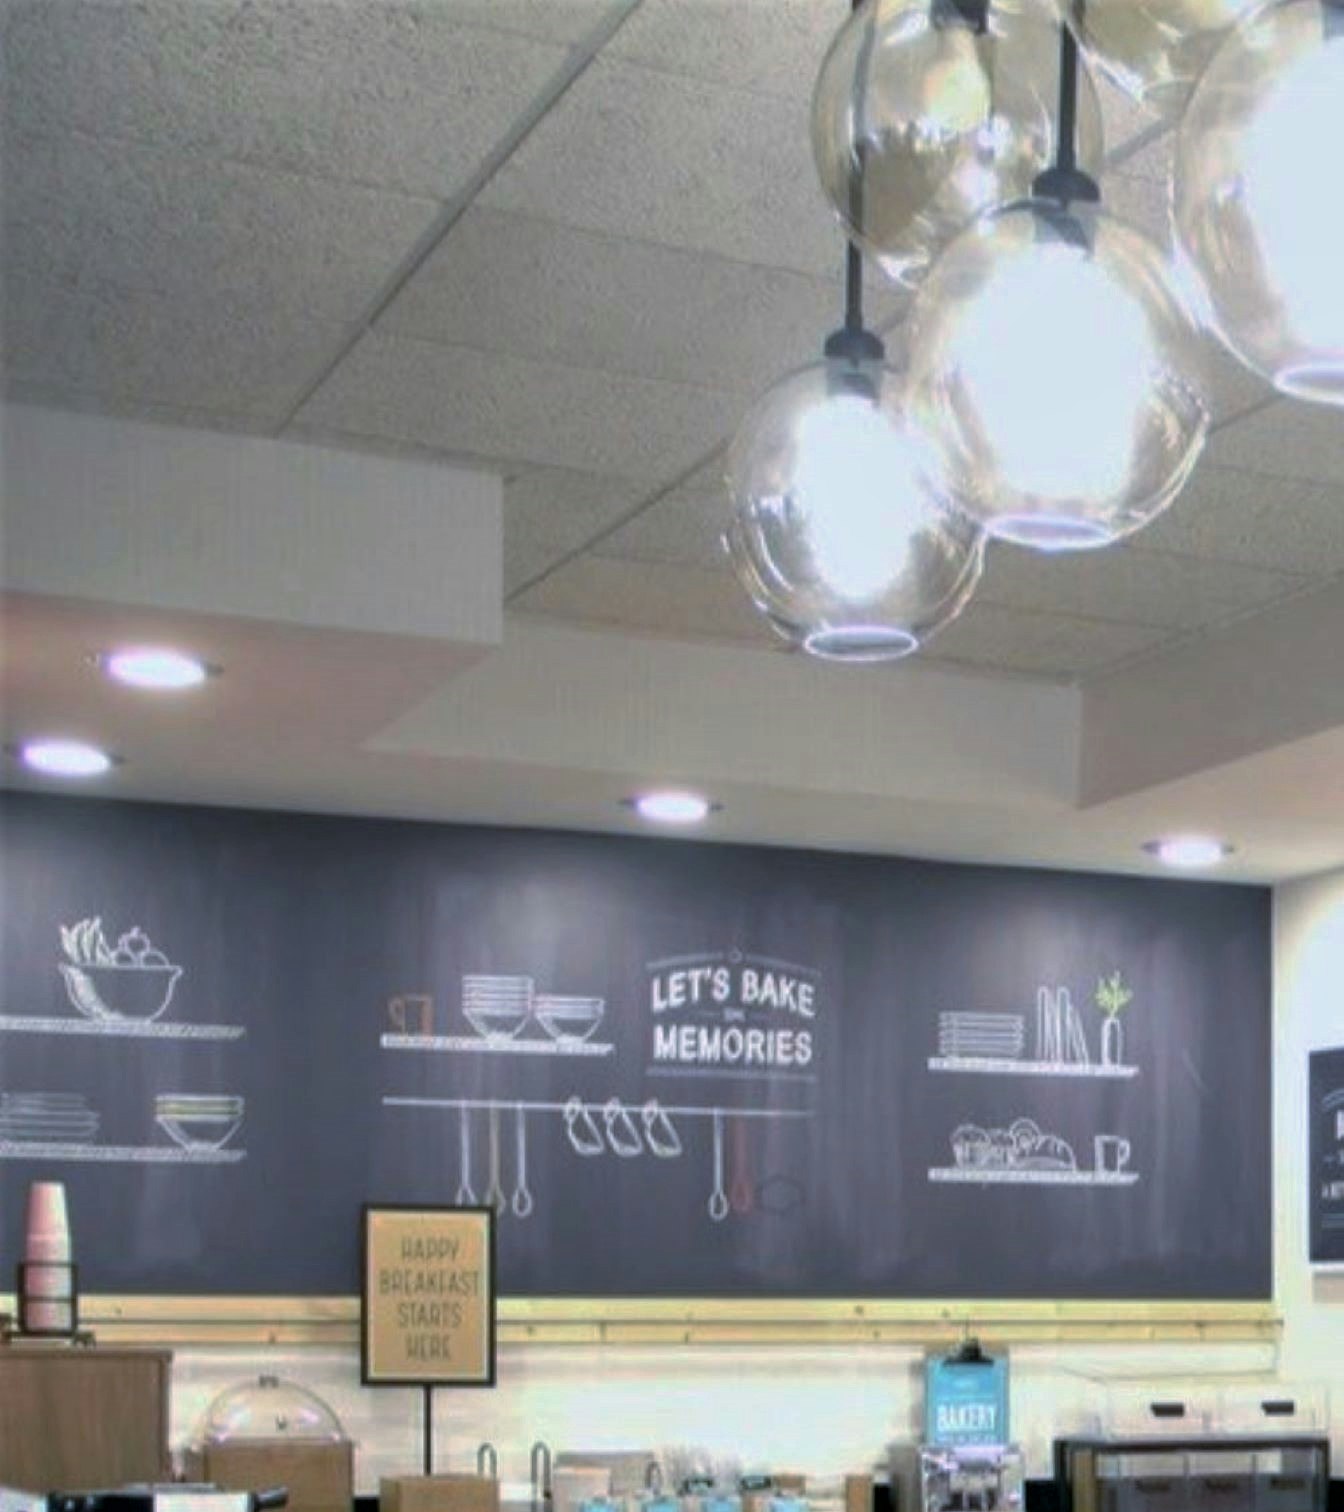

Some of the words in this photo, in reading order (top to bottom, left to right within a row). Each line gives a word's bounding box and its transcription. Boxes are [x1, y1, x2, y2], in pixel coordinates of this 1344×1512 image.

[652, 966, 731, 1013] LET'S
[742, 968, 816, 1018] BAKE
[653, 1024, 813, 1065] MEMORIES
[401, 1236, 459, 1261] HAPPY
[378, 1269, 479, 1296] BREAKFAST
[398, 1302, 462, 1328] STARTS
[406, 1333, 451, 1361] HERE
[937, 1403, 996, 1431] BAKERY
